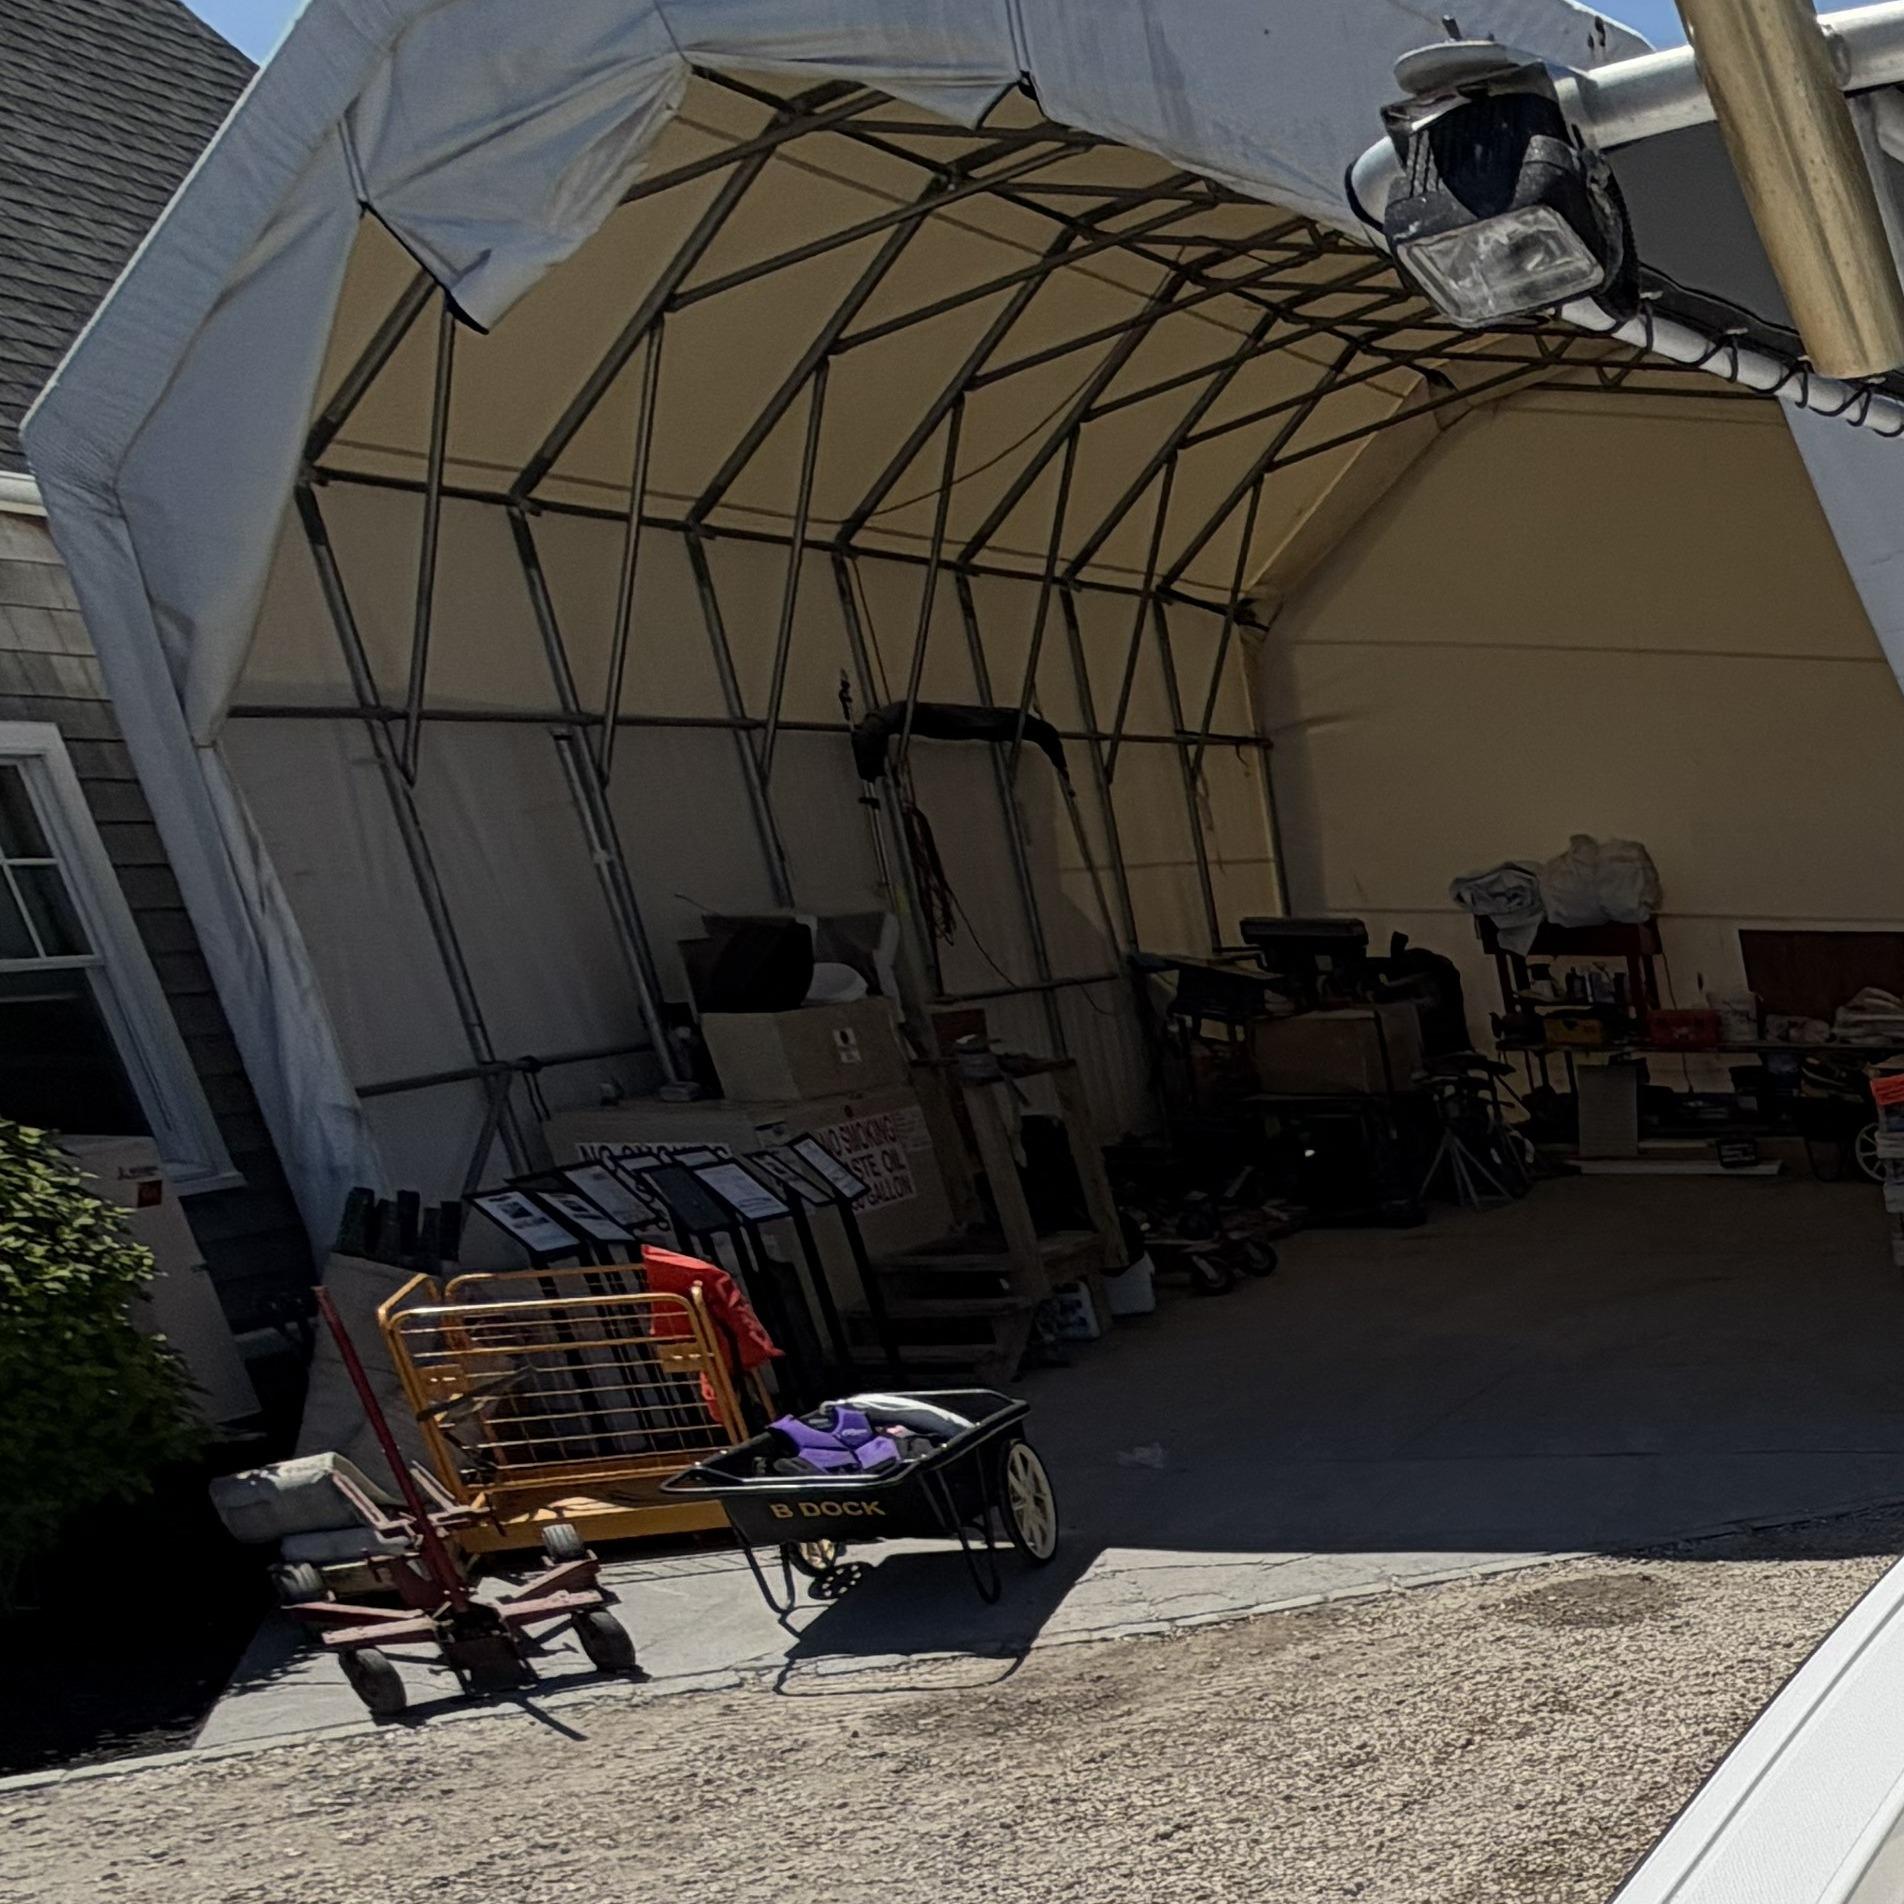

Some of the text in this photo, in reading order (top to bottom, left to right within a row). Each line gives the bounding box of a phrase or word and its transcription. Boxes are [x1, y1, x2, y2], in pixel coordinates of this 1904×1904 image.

[838, 1115, 897, 1154] SMOKING
[881, 1149, 906, 1174] OIL
[769, 1500, 887, 1519] B DOCK
